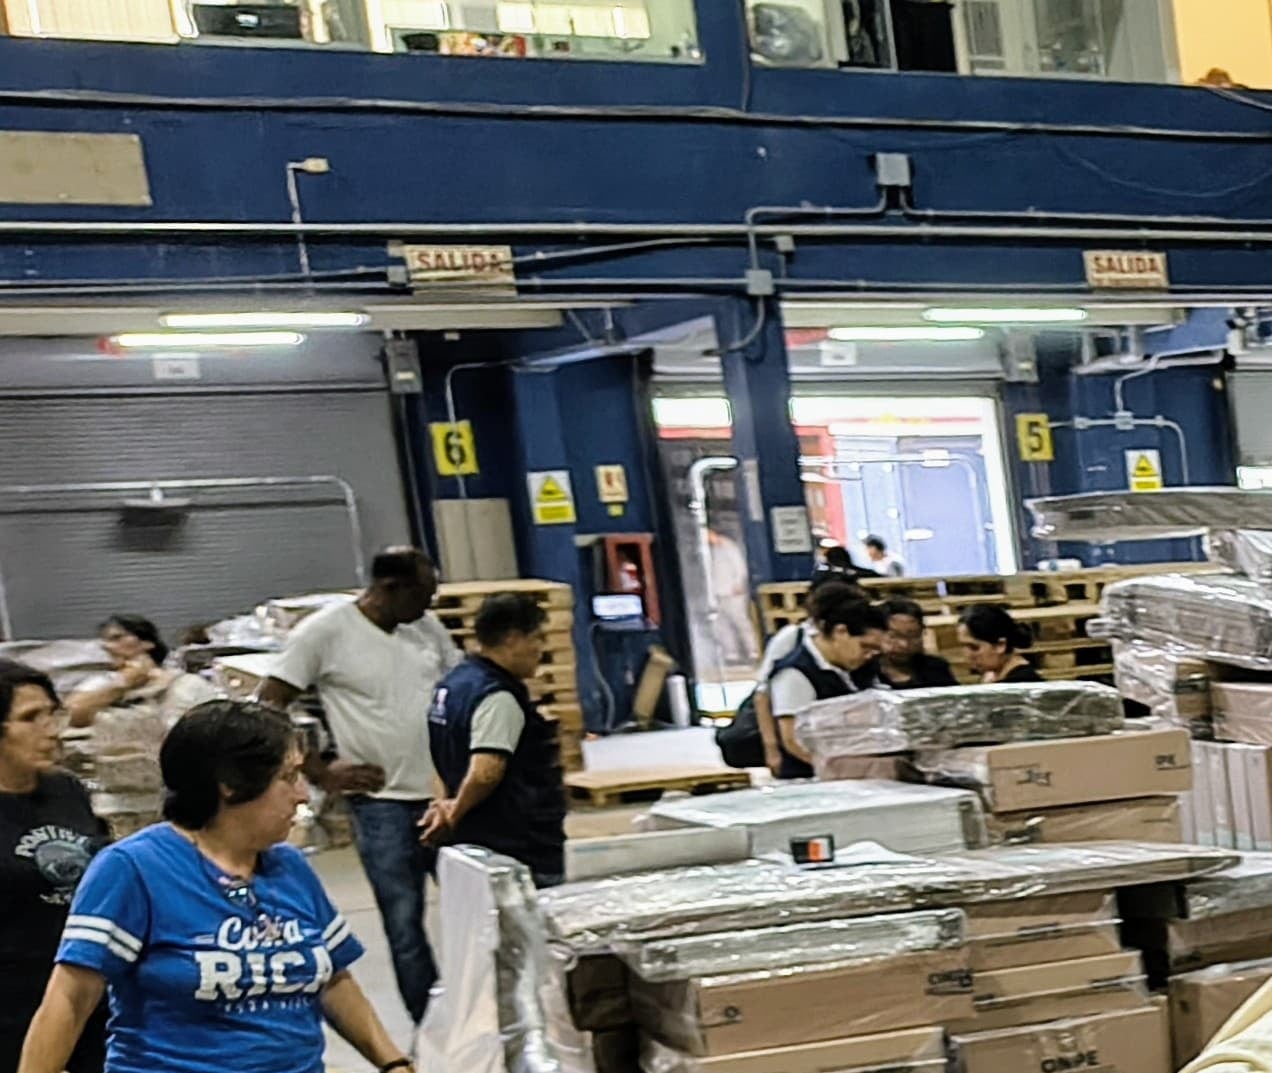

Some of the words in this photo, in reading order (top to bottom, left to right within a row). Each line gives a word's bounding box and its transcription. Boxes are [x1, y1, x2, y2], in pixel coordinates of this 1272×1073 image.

[416, 250, 505, 272] SALIDA
[1093, 255, 1160, 274] SALIDA
[444, 431, 467, 466] 6
[1028, 420, 1043, 452] 5
